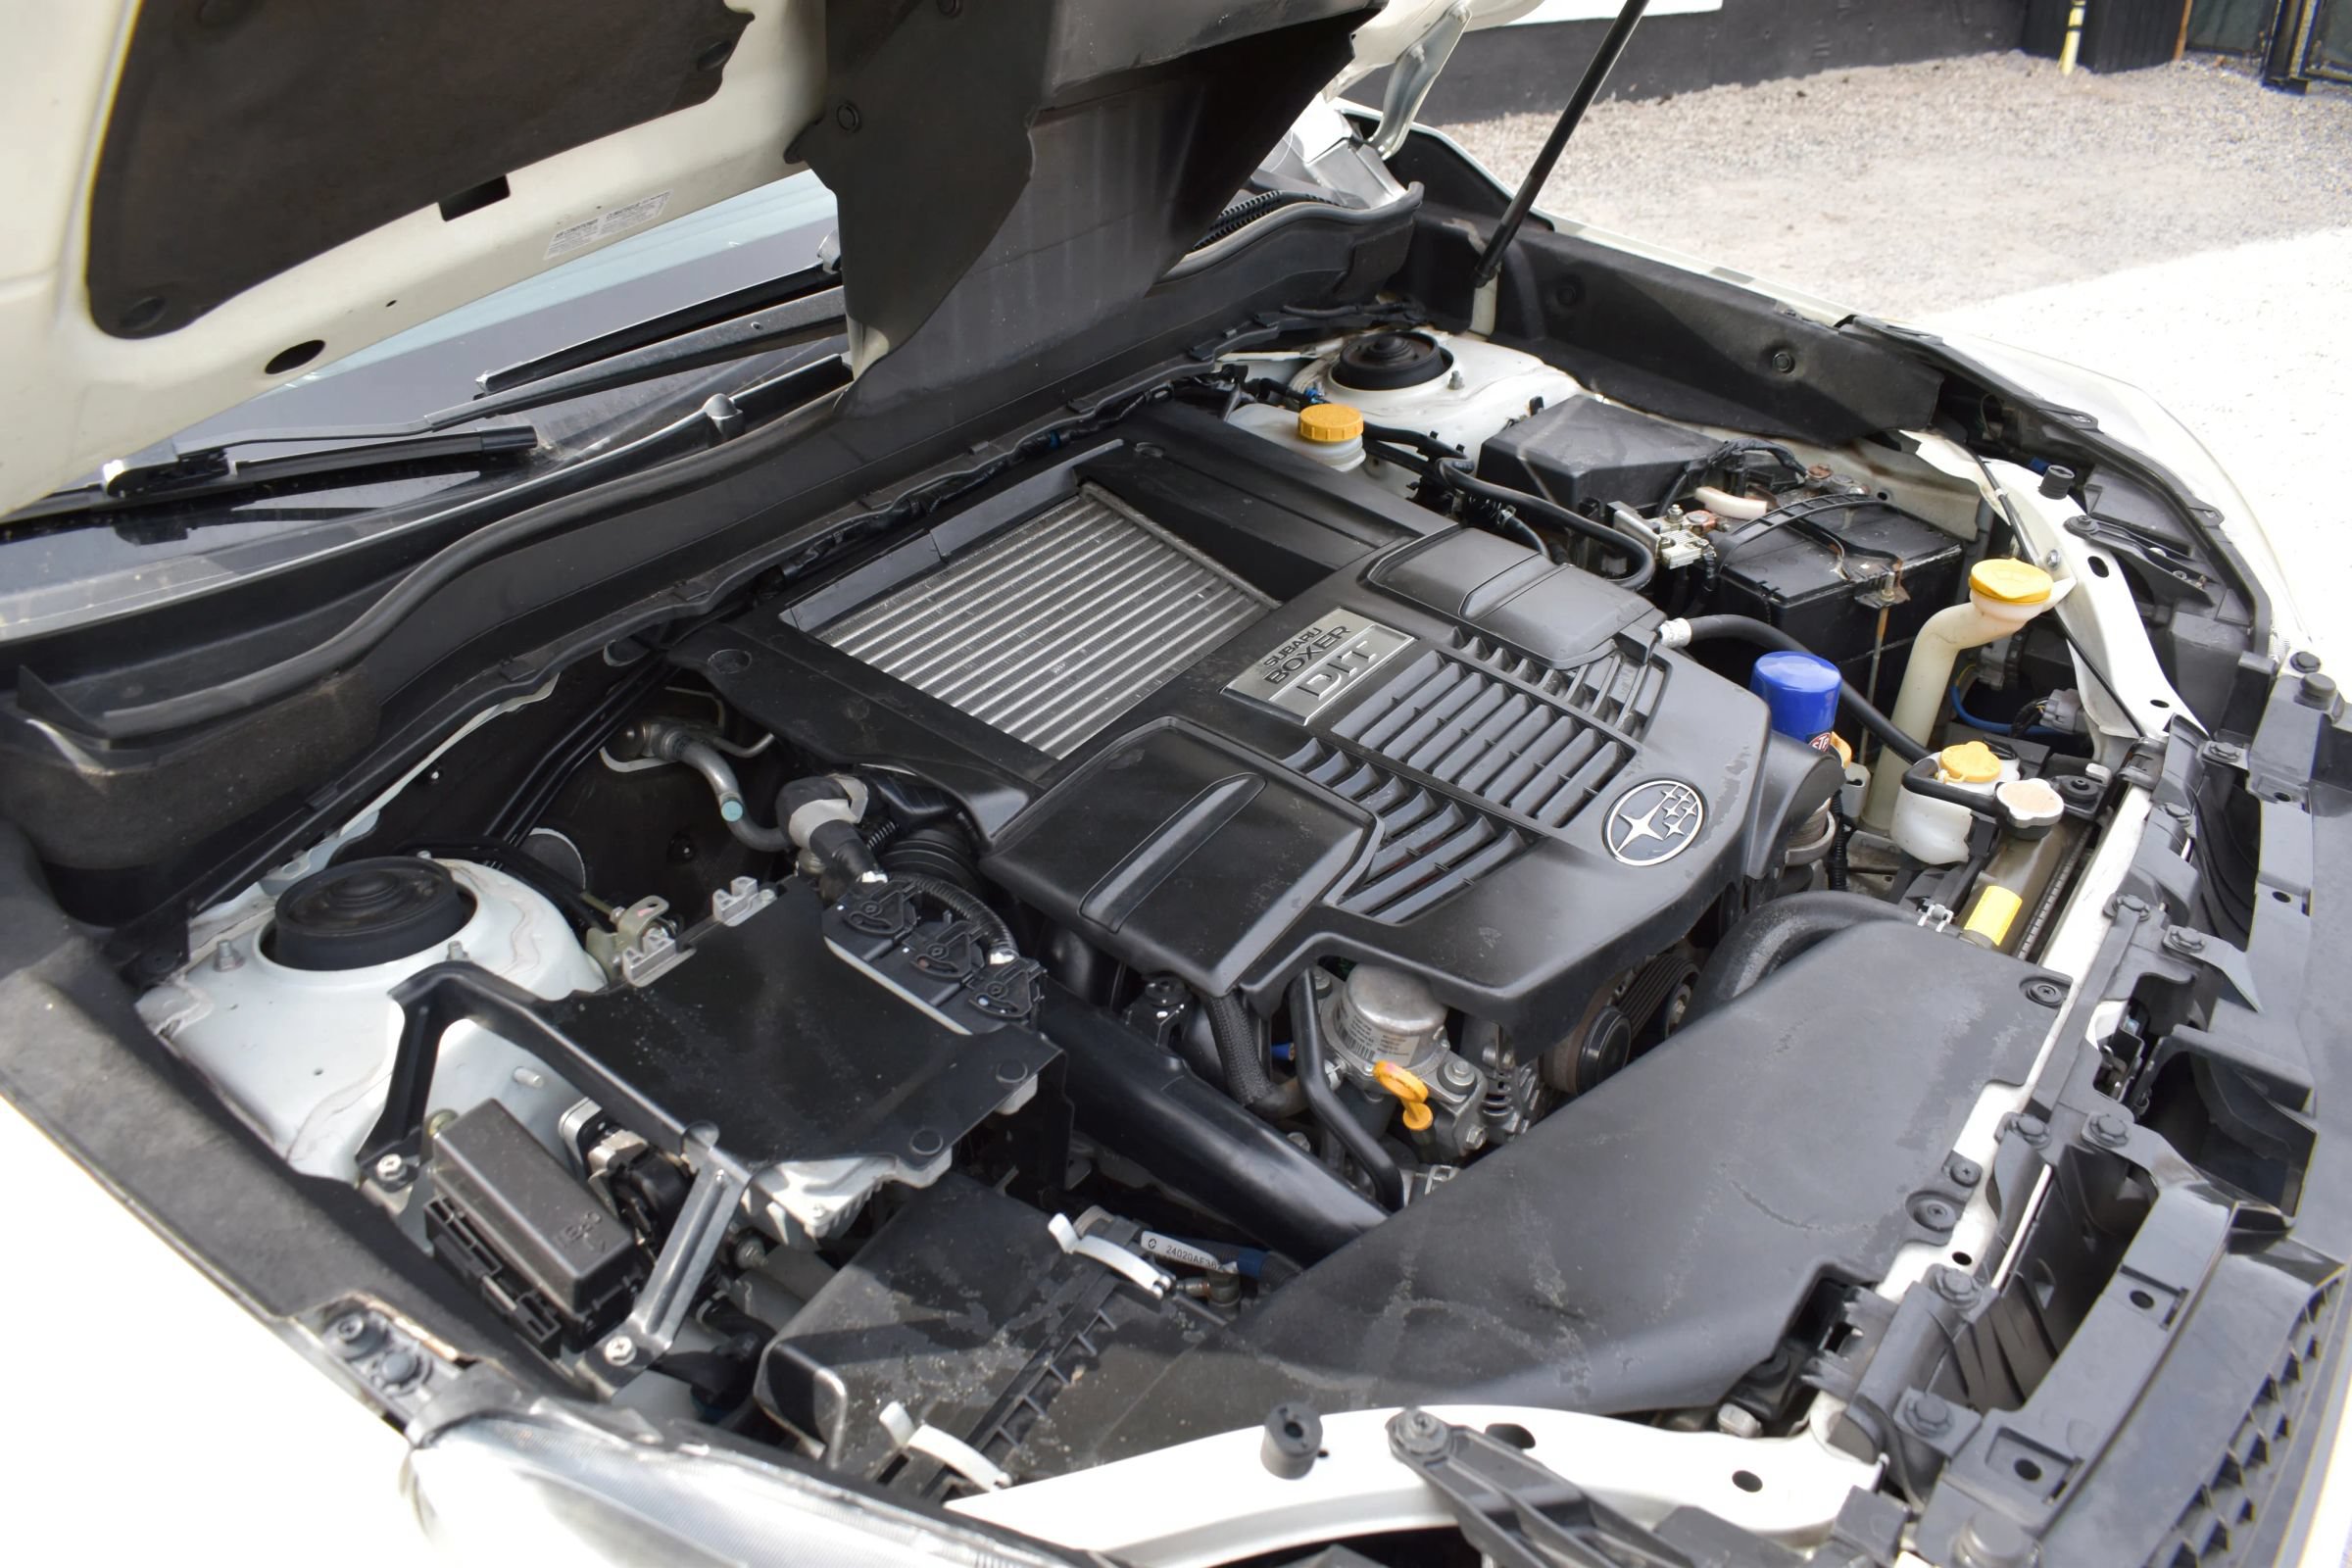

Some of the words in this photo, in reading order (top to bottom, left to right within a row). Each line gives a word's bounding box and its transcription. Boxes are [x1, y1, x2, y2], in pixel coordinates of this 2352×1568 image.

[1263, 627, 1322, 666] SUBARU
[1264, 625, 1350, 684] BOXER
[1297, 640, 1376, 701] DIT
